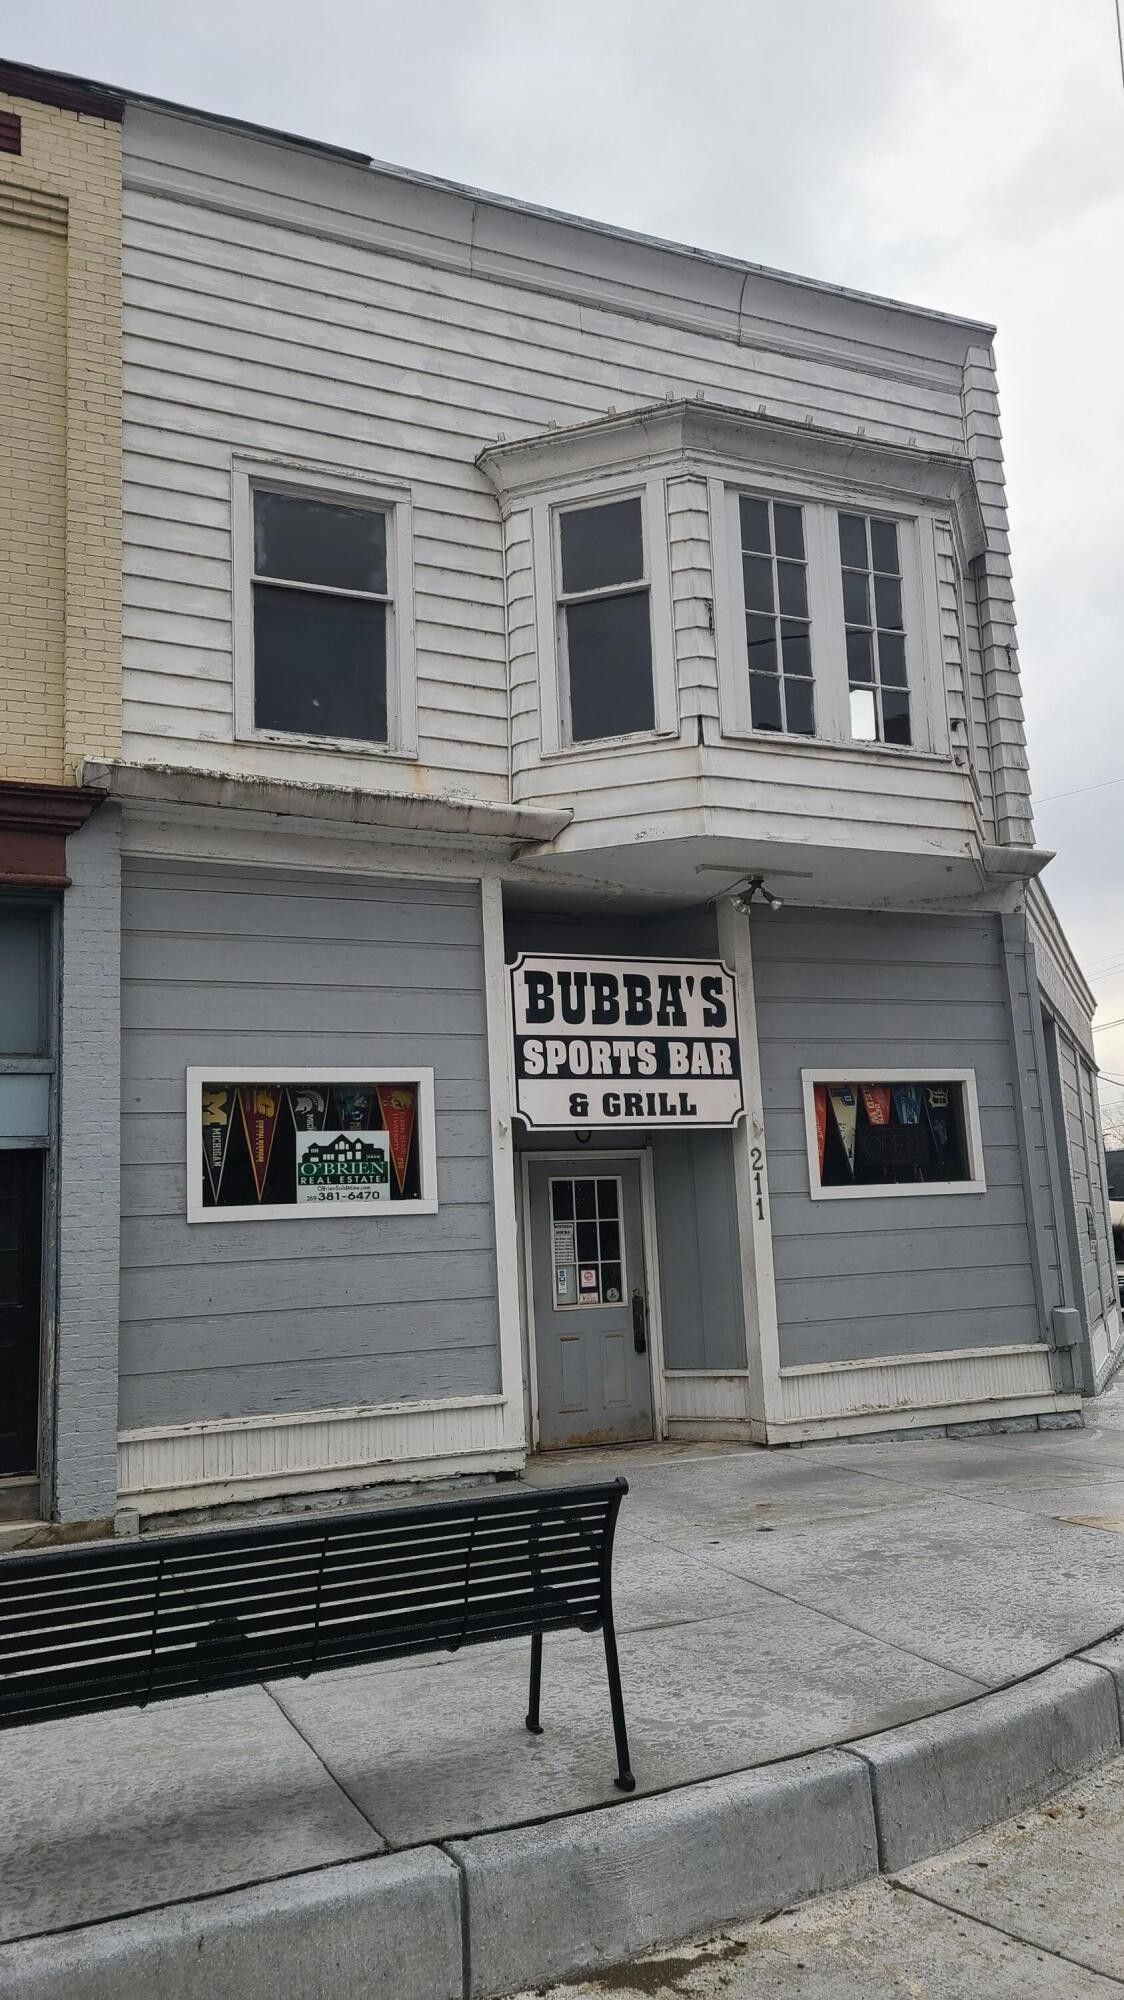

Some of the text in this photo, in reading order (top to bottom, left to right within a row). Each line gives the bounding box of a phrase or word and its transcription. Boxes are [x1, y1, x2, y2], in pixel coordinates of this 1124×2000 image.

[524, 970, 728, 1028] BUBBA'S
[523, 1039, 733, 1076] SPORTS BAR
[569, 1092, 697, 1117] & GRILL
[211, 1127, 223, 1168] MICHIGAN
[300, 1161, 385, 1176] O'BRIEN
[300, 1176, 332, 1185] REAL
[339, 1175, 382, 1184] ESTATE
[750, 1147, 765, 1220] 211
[317, 1191, 380, 1202] 381-6470
